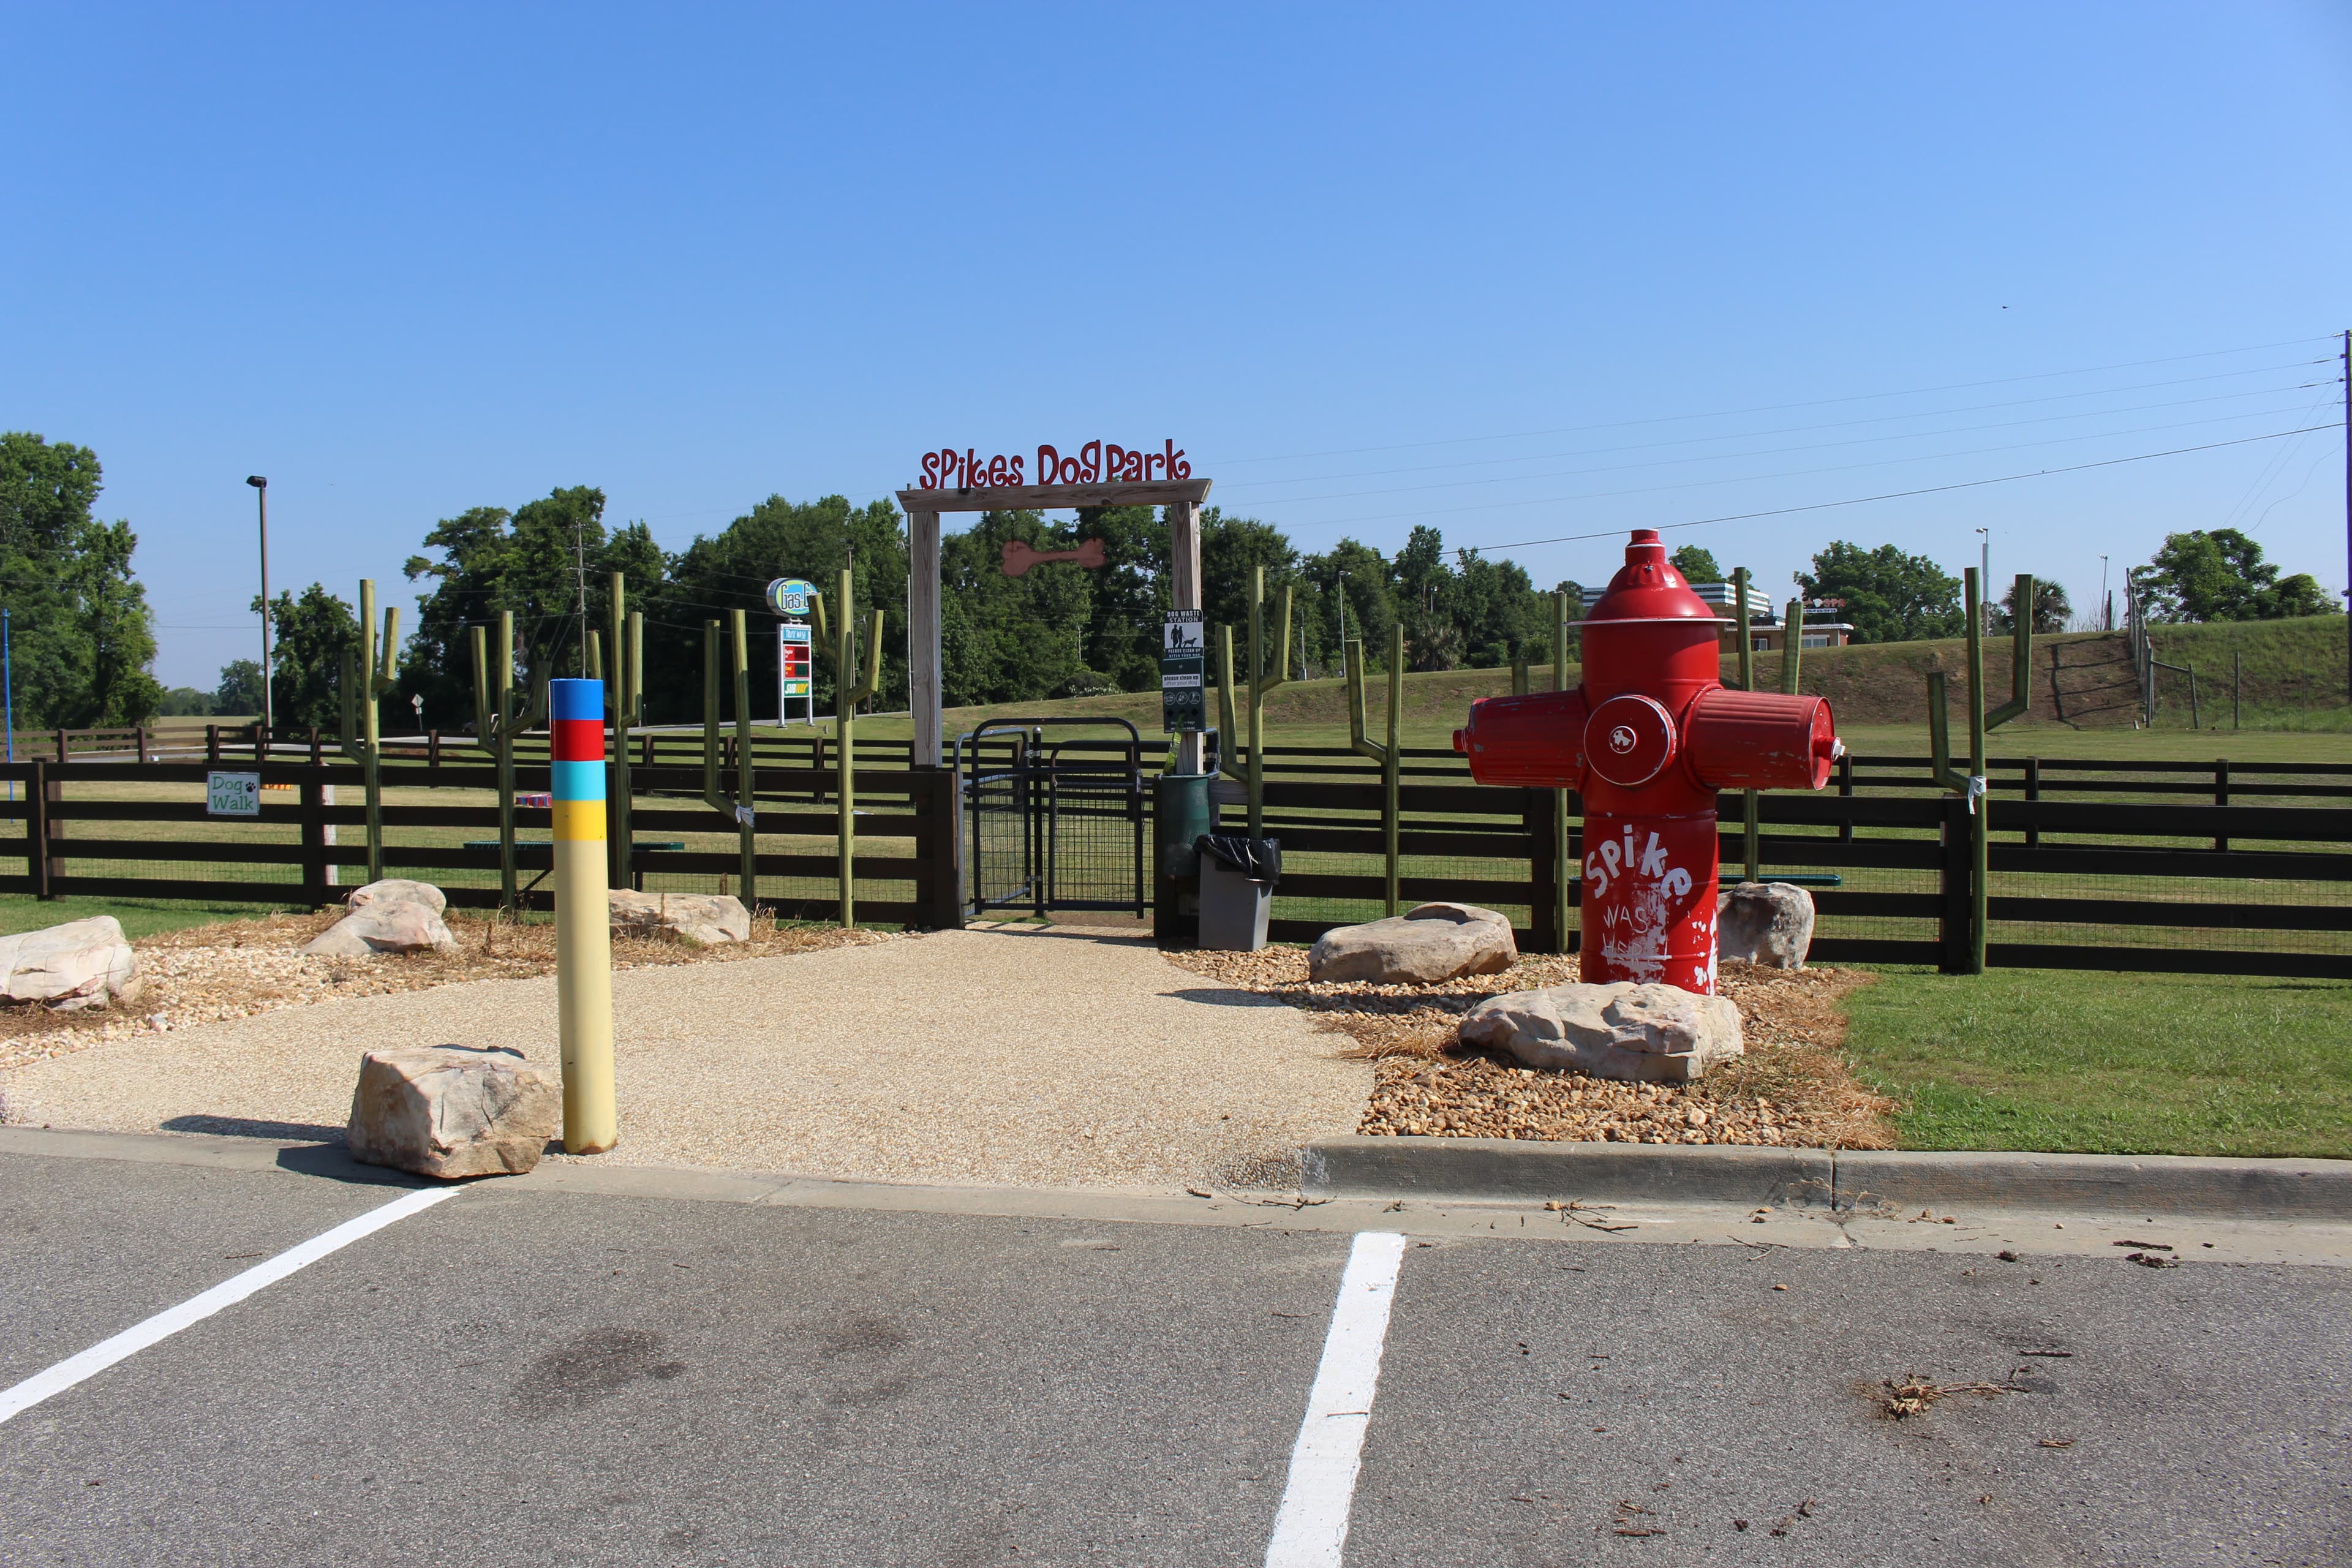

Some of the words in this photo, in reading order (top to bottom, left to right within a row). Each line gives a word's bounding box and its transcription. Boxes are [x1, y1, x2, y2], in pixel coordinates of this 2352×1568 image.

[1038, 439, 1101, 486] Dog
[785, 684, 808, 693] SUBWAY
[212, 776, 243, 794] Dog
[212, 795, 254, 810] Walk
[1603, 903, 1649, 934] WAS
